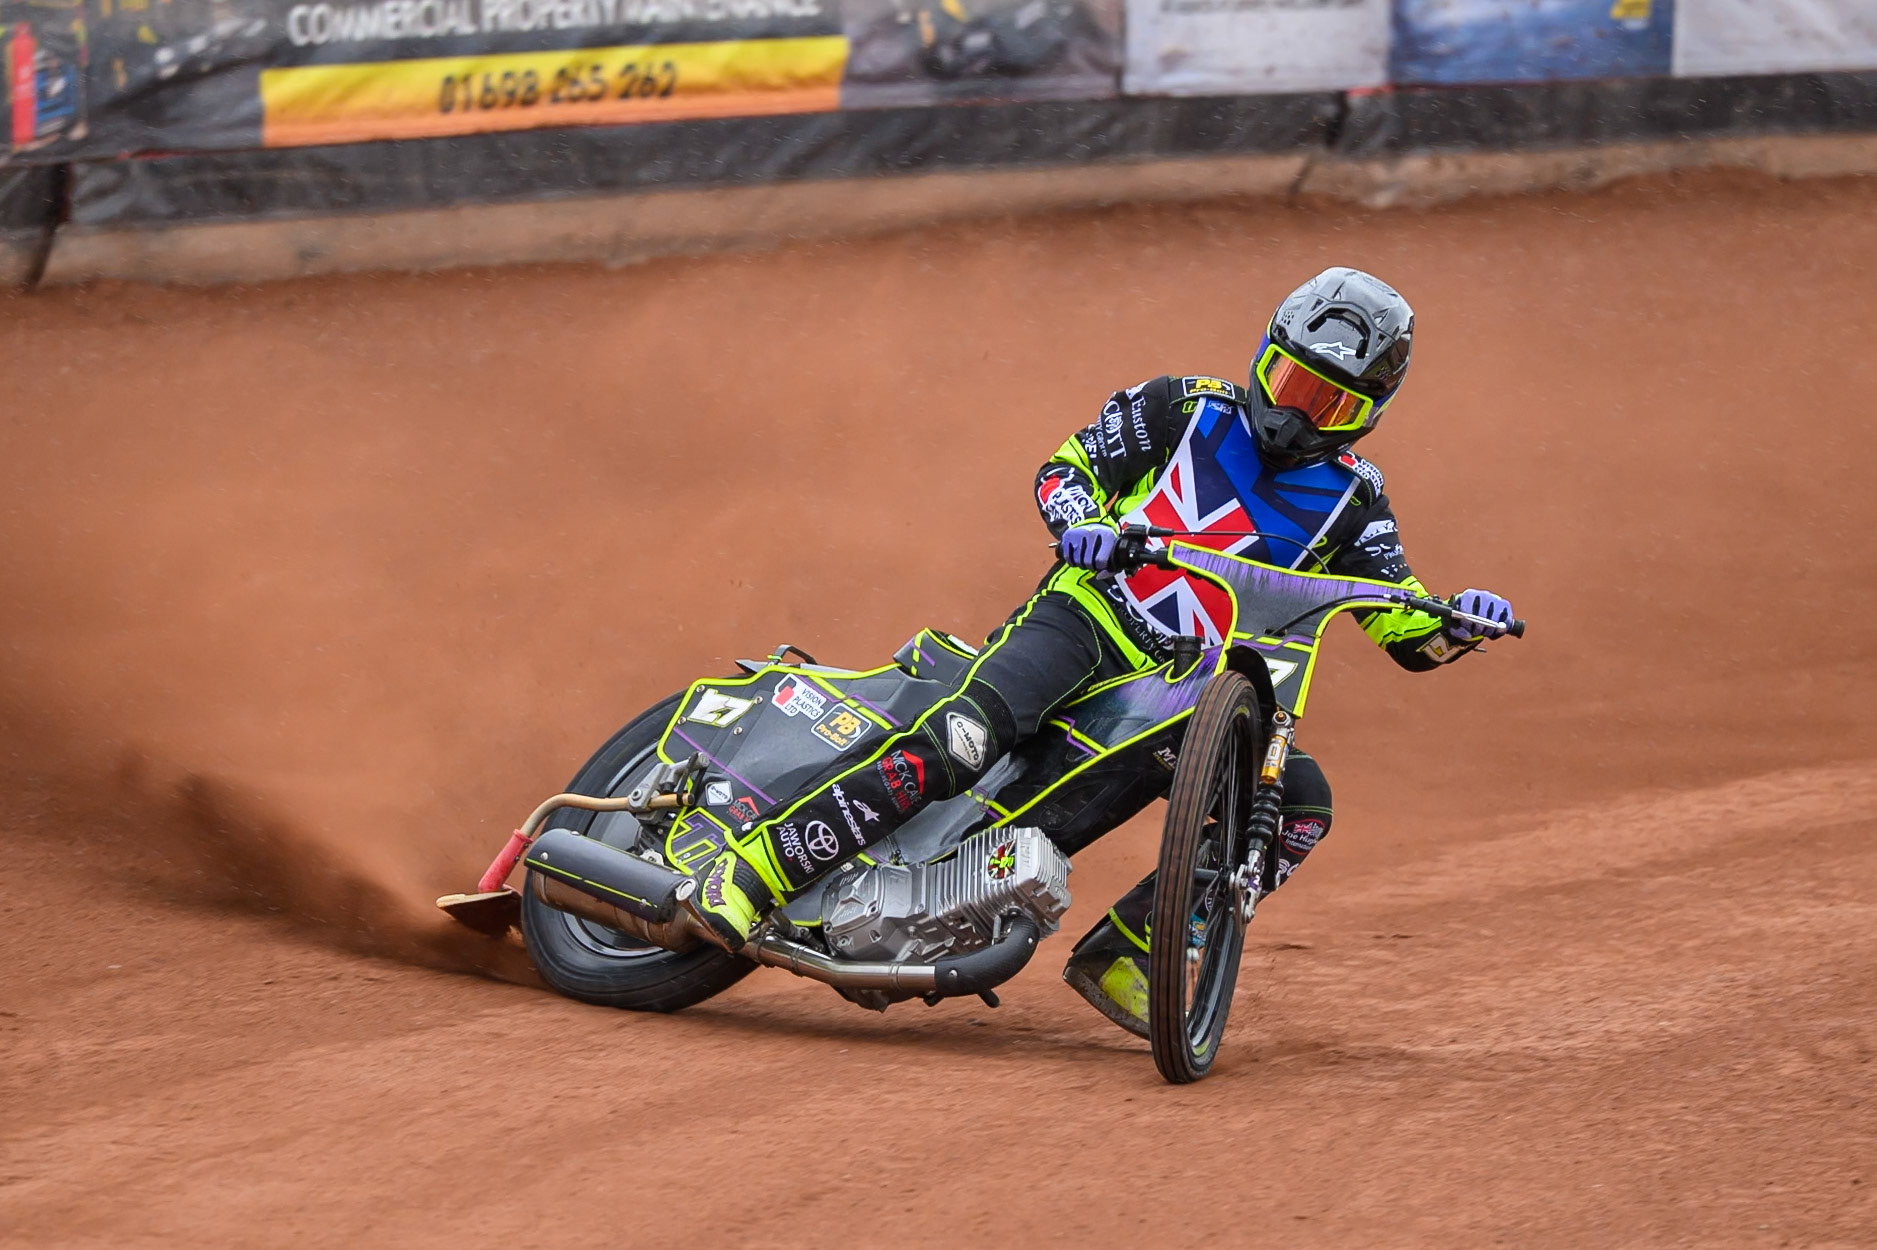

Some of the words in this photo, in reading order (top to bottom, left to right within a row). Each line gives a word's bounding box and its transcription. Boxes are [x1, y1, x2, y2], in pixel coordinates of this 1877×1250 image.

[289, 0, 477, 46] COMMERCIAL
[439, 69, 540, 114] 01698
[550, 64, 608, 103] 265
[617, 60, 676, 100] 262
[1131, 395, 1152, 452] Euston
[784, 703, 798, 714] LTD
[793, 696, 821, 718] PLASTICS
[801, 688, 822, 706] VISION
[829, 711, 862, 735] PB
[882, 756, 902, 789] GRAB
[832, 783, 867, 846] alpinestars
[784, 822, 815, 874] JAWORSKI
